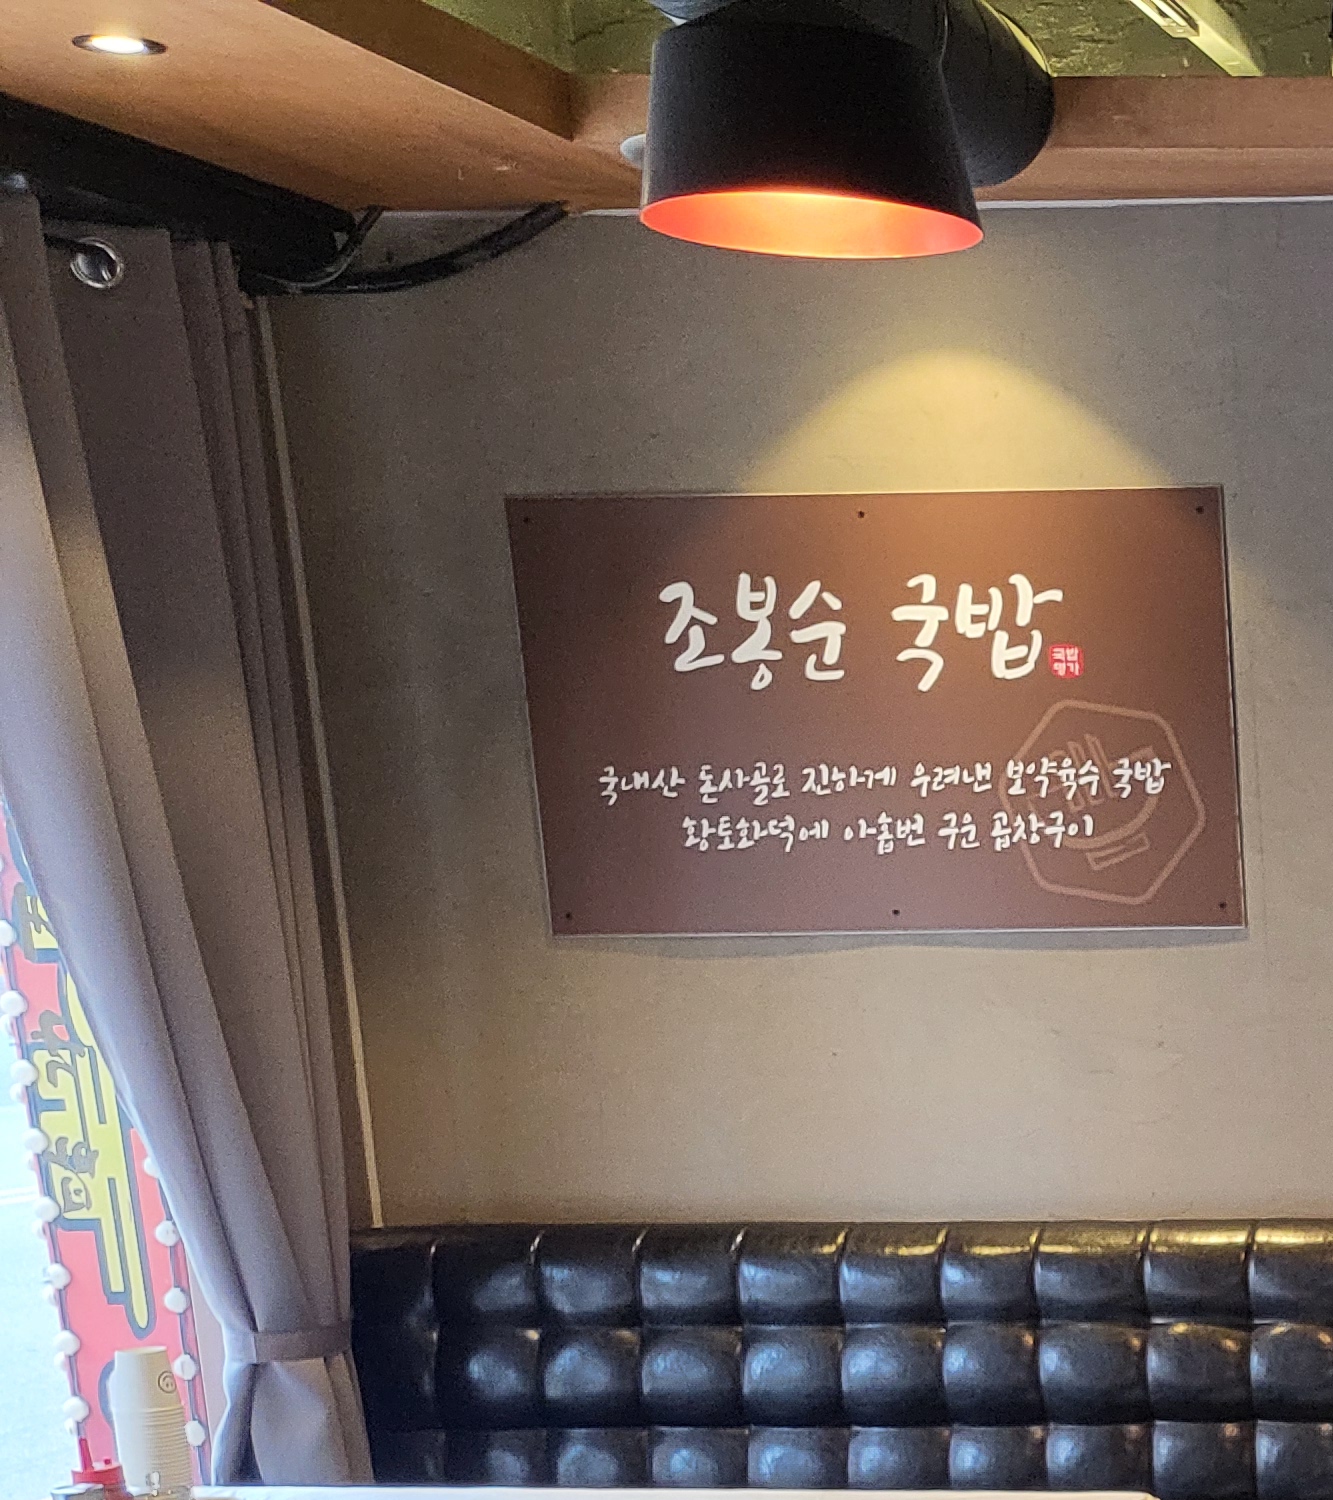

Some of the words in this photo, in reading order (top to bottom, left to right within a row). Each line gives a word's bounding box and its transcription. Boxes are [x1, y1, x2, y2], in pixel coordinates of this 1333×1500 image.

[659, 572, 847, 691] 조봉순
[891, 573, 1064, 692] 국밥
[599, 766, 686, 806] 국내산
[698, 761, 791, 806] 돈사골로
[801, 763, 897, 796] 진하게
[910, 762, 992, 798] 우려낸
[1006, 756, 1100, 801] 보약육수
[1112, 757, 1172, 799] 국밥
[682, 814, 829, 853] 황토화덕에
[843, 811, 926, 855] 아홉번
[937, 812, 981, 850] 구운
[990, 810, 1094, 852] 곱창구이
